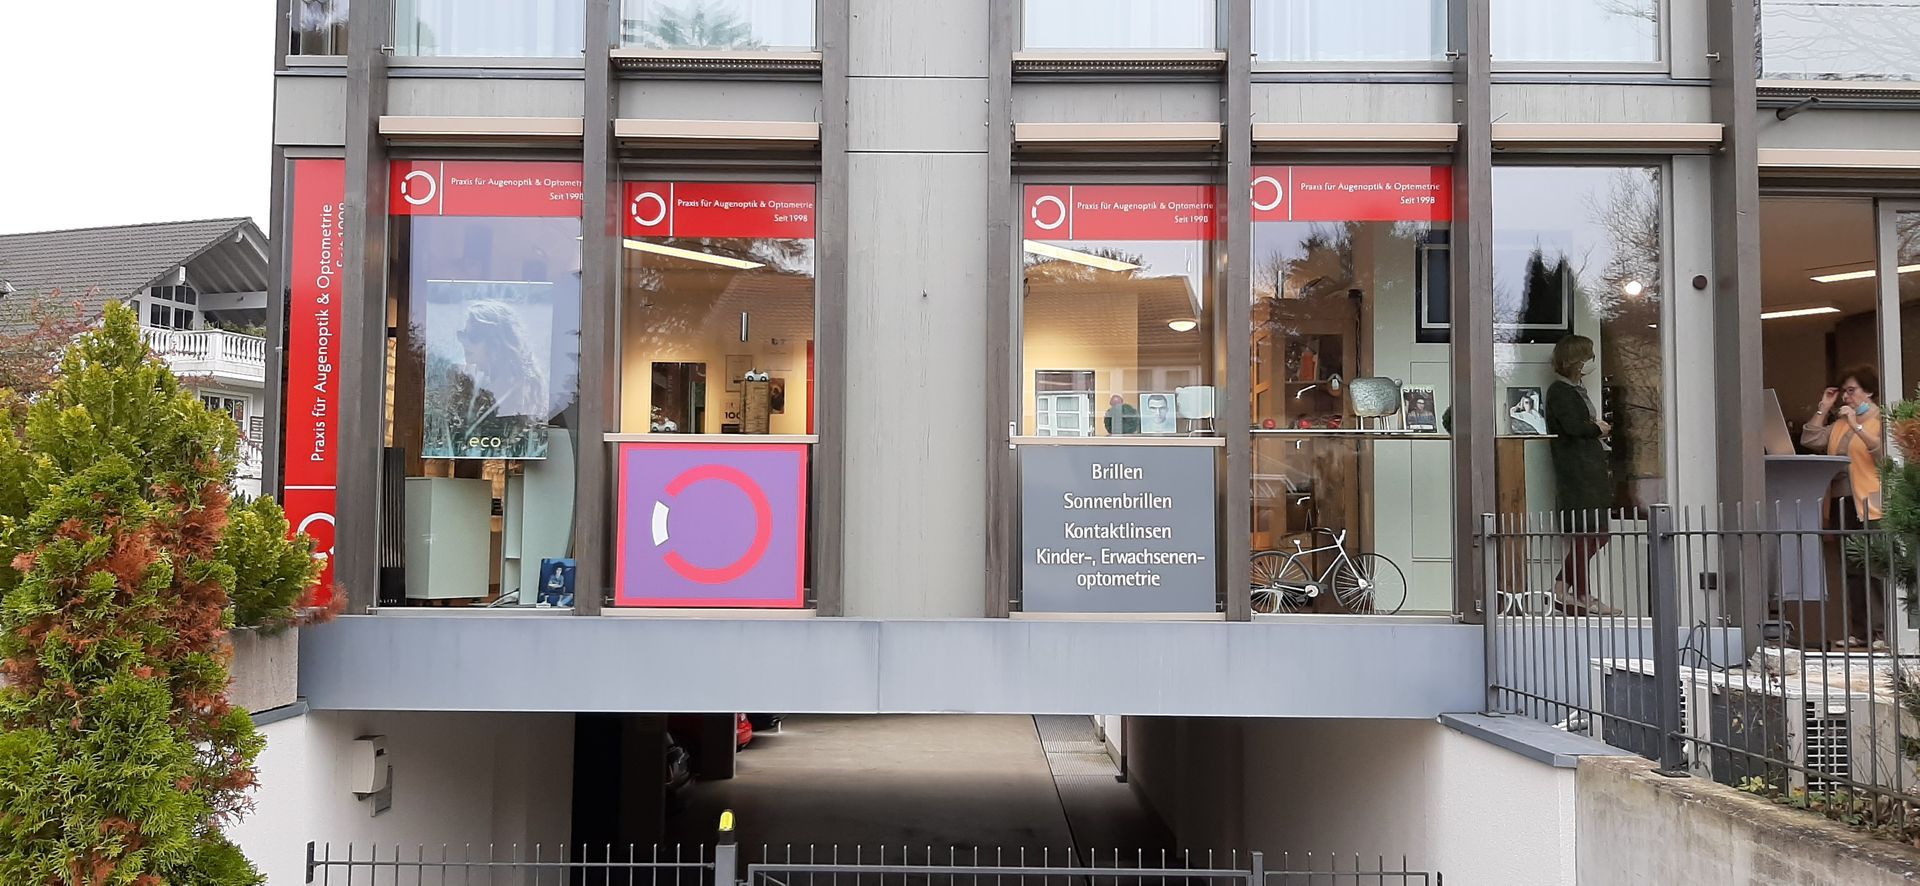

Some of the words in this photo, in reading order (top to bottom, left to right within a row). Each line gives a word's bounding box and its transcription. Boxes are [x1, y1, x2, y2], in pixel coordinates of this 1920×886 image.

[451, 177, 473, 186] Praxis
[475, 177, 486, 186] für
[488, 178, 533, 188] Augenoptik
[535, 178, 542, 186] &
[1300, 182, 1323, 191] Praxis
[1324, 182, 1337, 191] für
[1338, 182, 1384, 193] Augenoptik
[1393, 183, 1441, 192] Optometrie
[549, 192, 564, 200] Seit
[1400, 196, 1415, 204] Seit
[1416, 196, 1436, 204] 1998
[677, 199, 699, 208] Praxis
[700, 199, 712, 208] für
[713, 199, 758, 210] Augenoptik
[759, 200, 766, 208] &
[768, 200, 813, 210] Optometrie
[1077, 201, 1099, 210] Praxis
[1100, 201, 1112, 210] für
[1113, 202, 1157, 212] Augenoptik
[1159, 202, 1166, 210] &
[1167, 202, 1214, 212] Optometrie
[774, 214, 788, 222] Seit
[789, 214, 808, 223] 1998
[1174, 215, 1188, 224] Seit
[1189, 215, 1209, 224] 1998
[316, 203, 334, 289] Optometrie
[316, 293, 330, 305] &
[313, 308, 333, 393] Augenoptik
[311, 397, 327, 418] für
[311, 421, 326, 461] Praxis
[469, 436, 501, 448] eco
[1091, 463, 1143, 480] Brillen
[1063, 492, 1172, 509] Sonnenbrillen
[1064, 522, 1172, 539] Kontaktlinsen
[1036, 548, 1097, 566] Kinder-,
[1101, 548, 1206, 565] Erwachsenen-
[1077, 570, 1161, 590] optometrie
